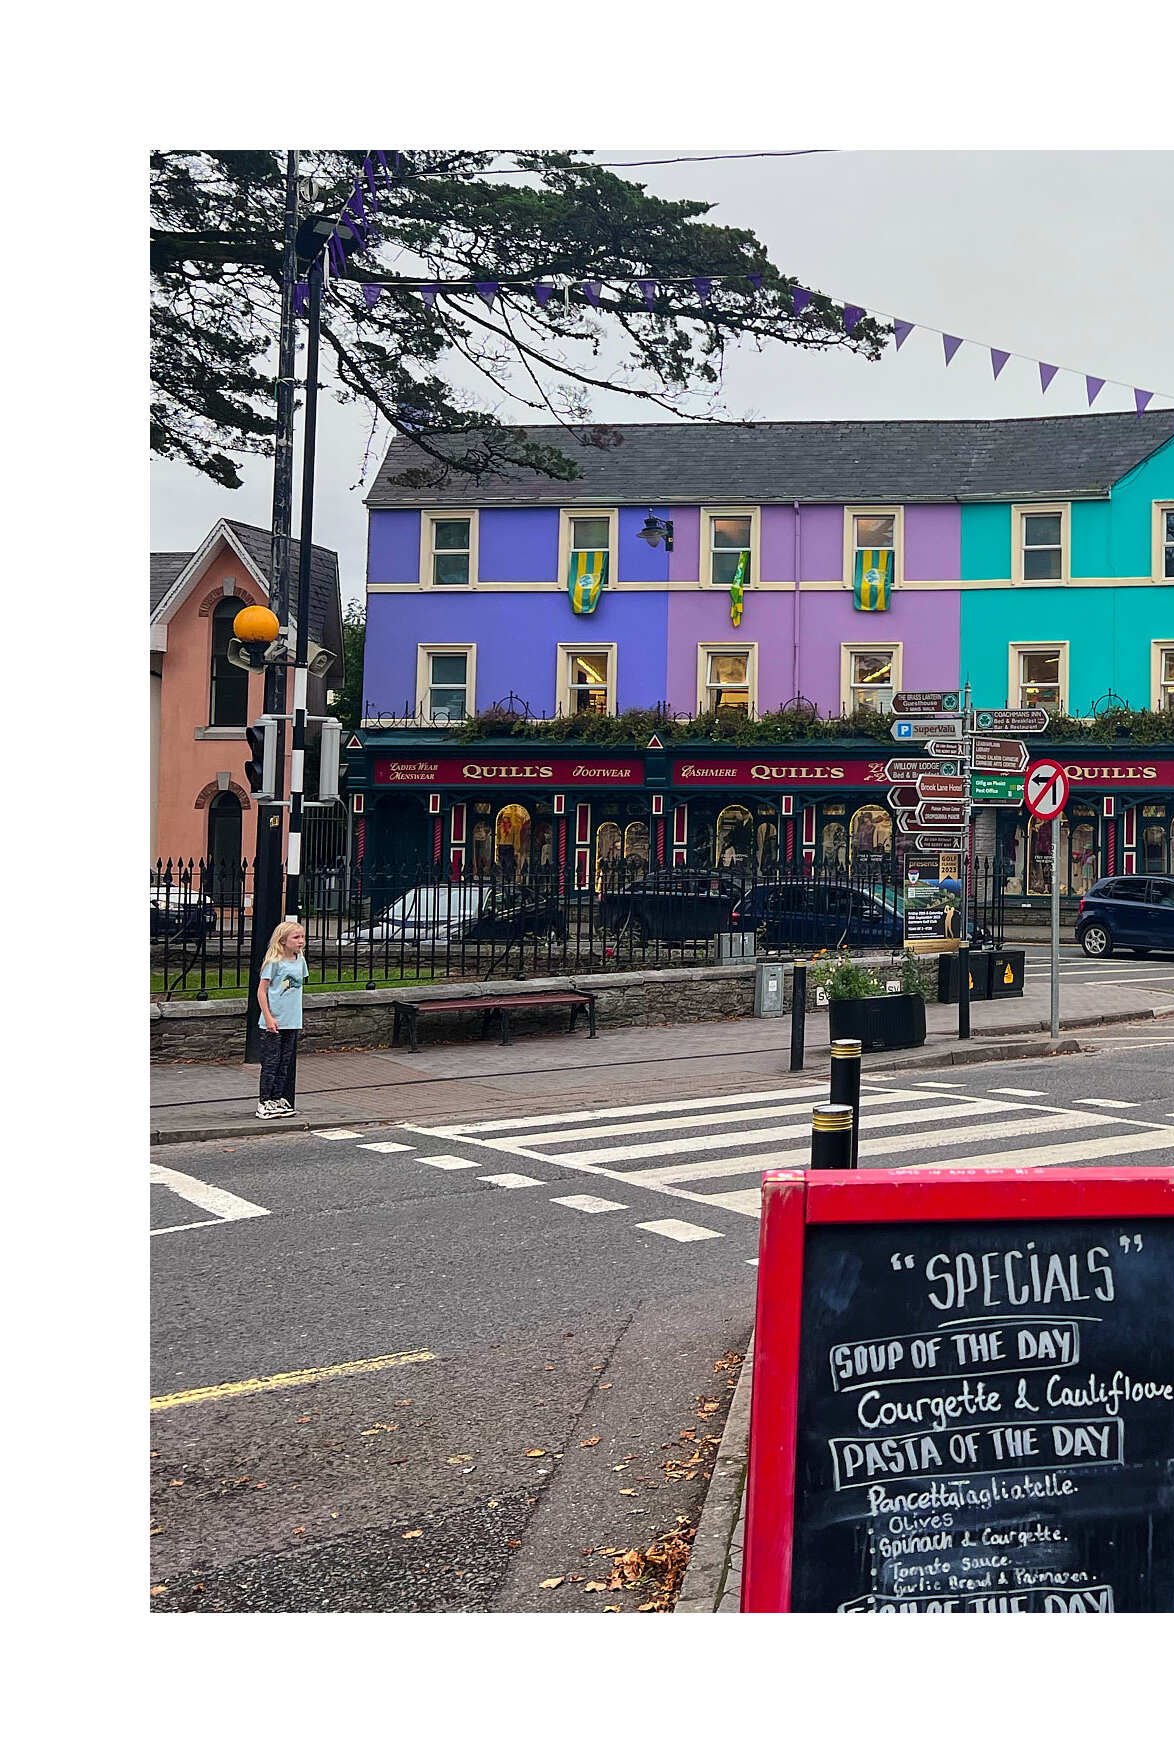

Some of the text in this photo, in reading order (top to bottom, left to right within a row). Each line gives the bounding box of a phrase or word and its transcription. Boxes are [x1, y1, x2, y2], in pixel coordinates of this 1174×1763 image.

[913, 725, 956, 735] SuperValu
[389, 762, 439, 771] LADIES WEAR
[462, 764, 554, 779] QUILL'S
[572, 765, 632, 778] FOOTWEAR
[681, 765, 738, 778] CASHMERE
[750, 765, 845, 780] QUILL'S
[893, 762, 917, 770] WILLOW
[918, 762, 940, 770] LODGE
[1063, 765, 1157, 780] QUILL'S
[389, 771, 436, 780] MENSWEAR
[892, 771, 904, 779] Bed
[920, 783, 963, 792] Brook Lane Hotel
[909, 861, 939, 869] presents
[833, 1328, 1074, 1379] SOUP OF THE DAY
[857, 1380, 1002, 1430] Courgette
[1013, 1377, 1040, 1412] &
[843, 1426, 1112, 1478] PASTA OF THE DAY
[879, 1524, 1069, 1558] Spinach & Courgette.
[890, 1557, 951, 1581] Tomato
